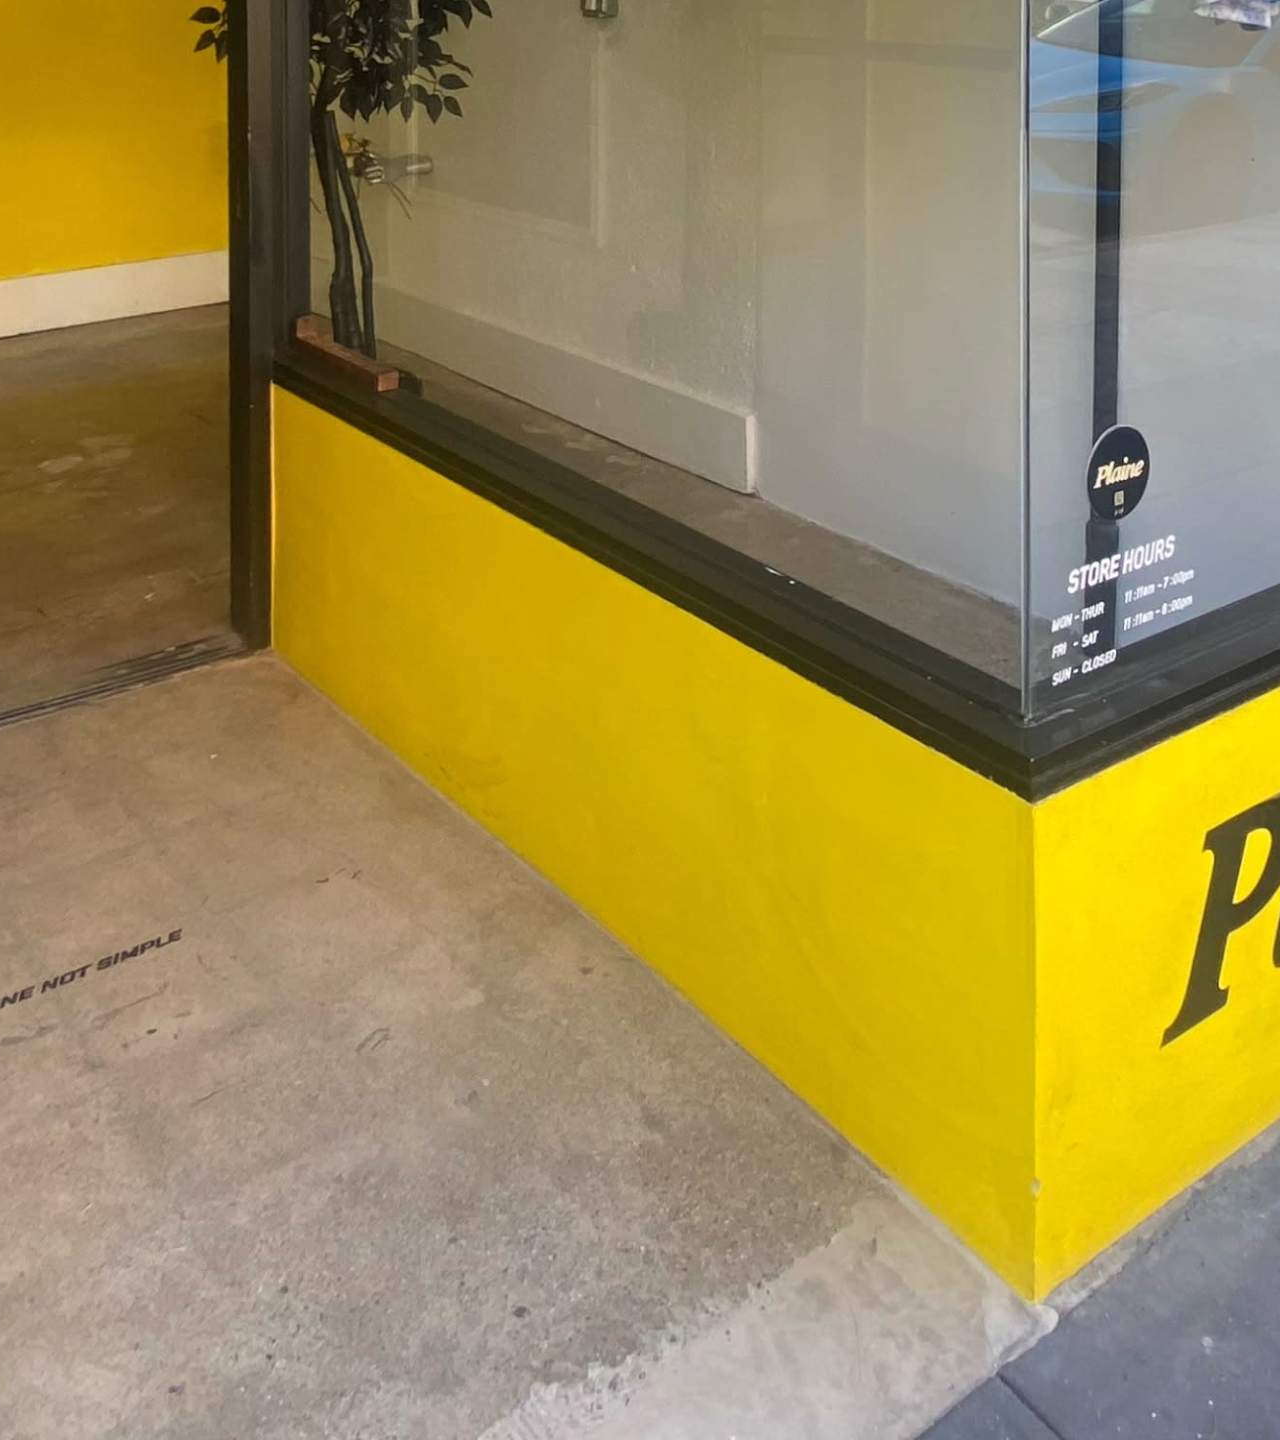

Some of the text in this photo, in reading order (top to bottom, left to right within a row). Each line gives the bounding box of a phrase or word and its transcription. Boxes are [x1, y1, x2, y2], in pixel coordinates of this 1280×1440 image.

[1093, 456, 1145, 489] Plaine
[1066, 533, 1177, 595] STORE HOURS
[1050, 612, 1074, 633] MON
[1080, 601, 1106, 622] THUR
[1051, 641, 1068, 659] FRI
[1080, 629, 1100, 648] SAT
[1051, 666, 1072, 686] SUN
[1081, 648, 1117, 674] CLOSED
[41, 963, 95, 994] NOT
[96, 928, 183, 971] SIMPLE
